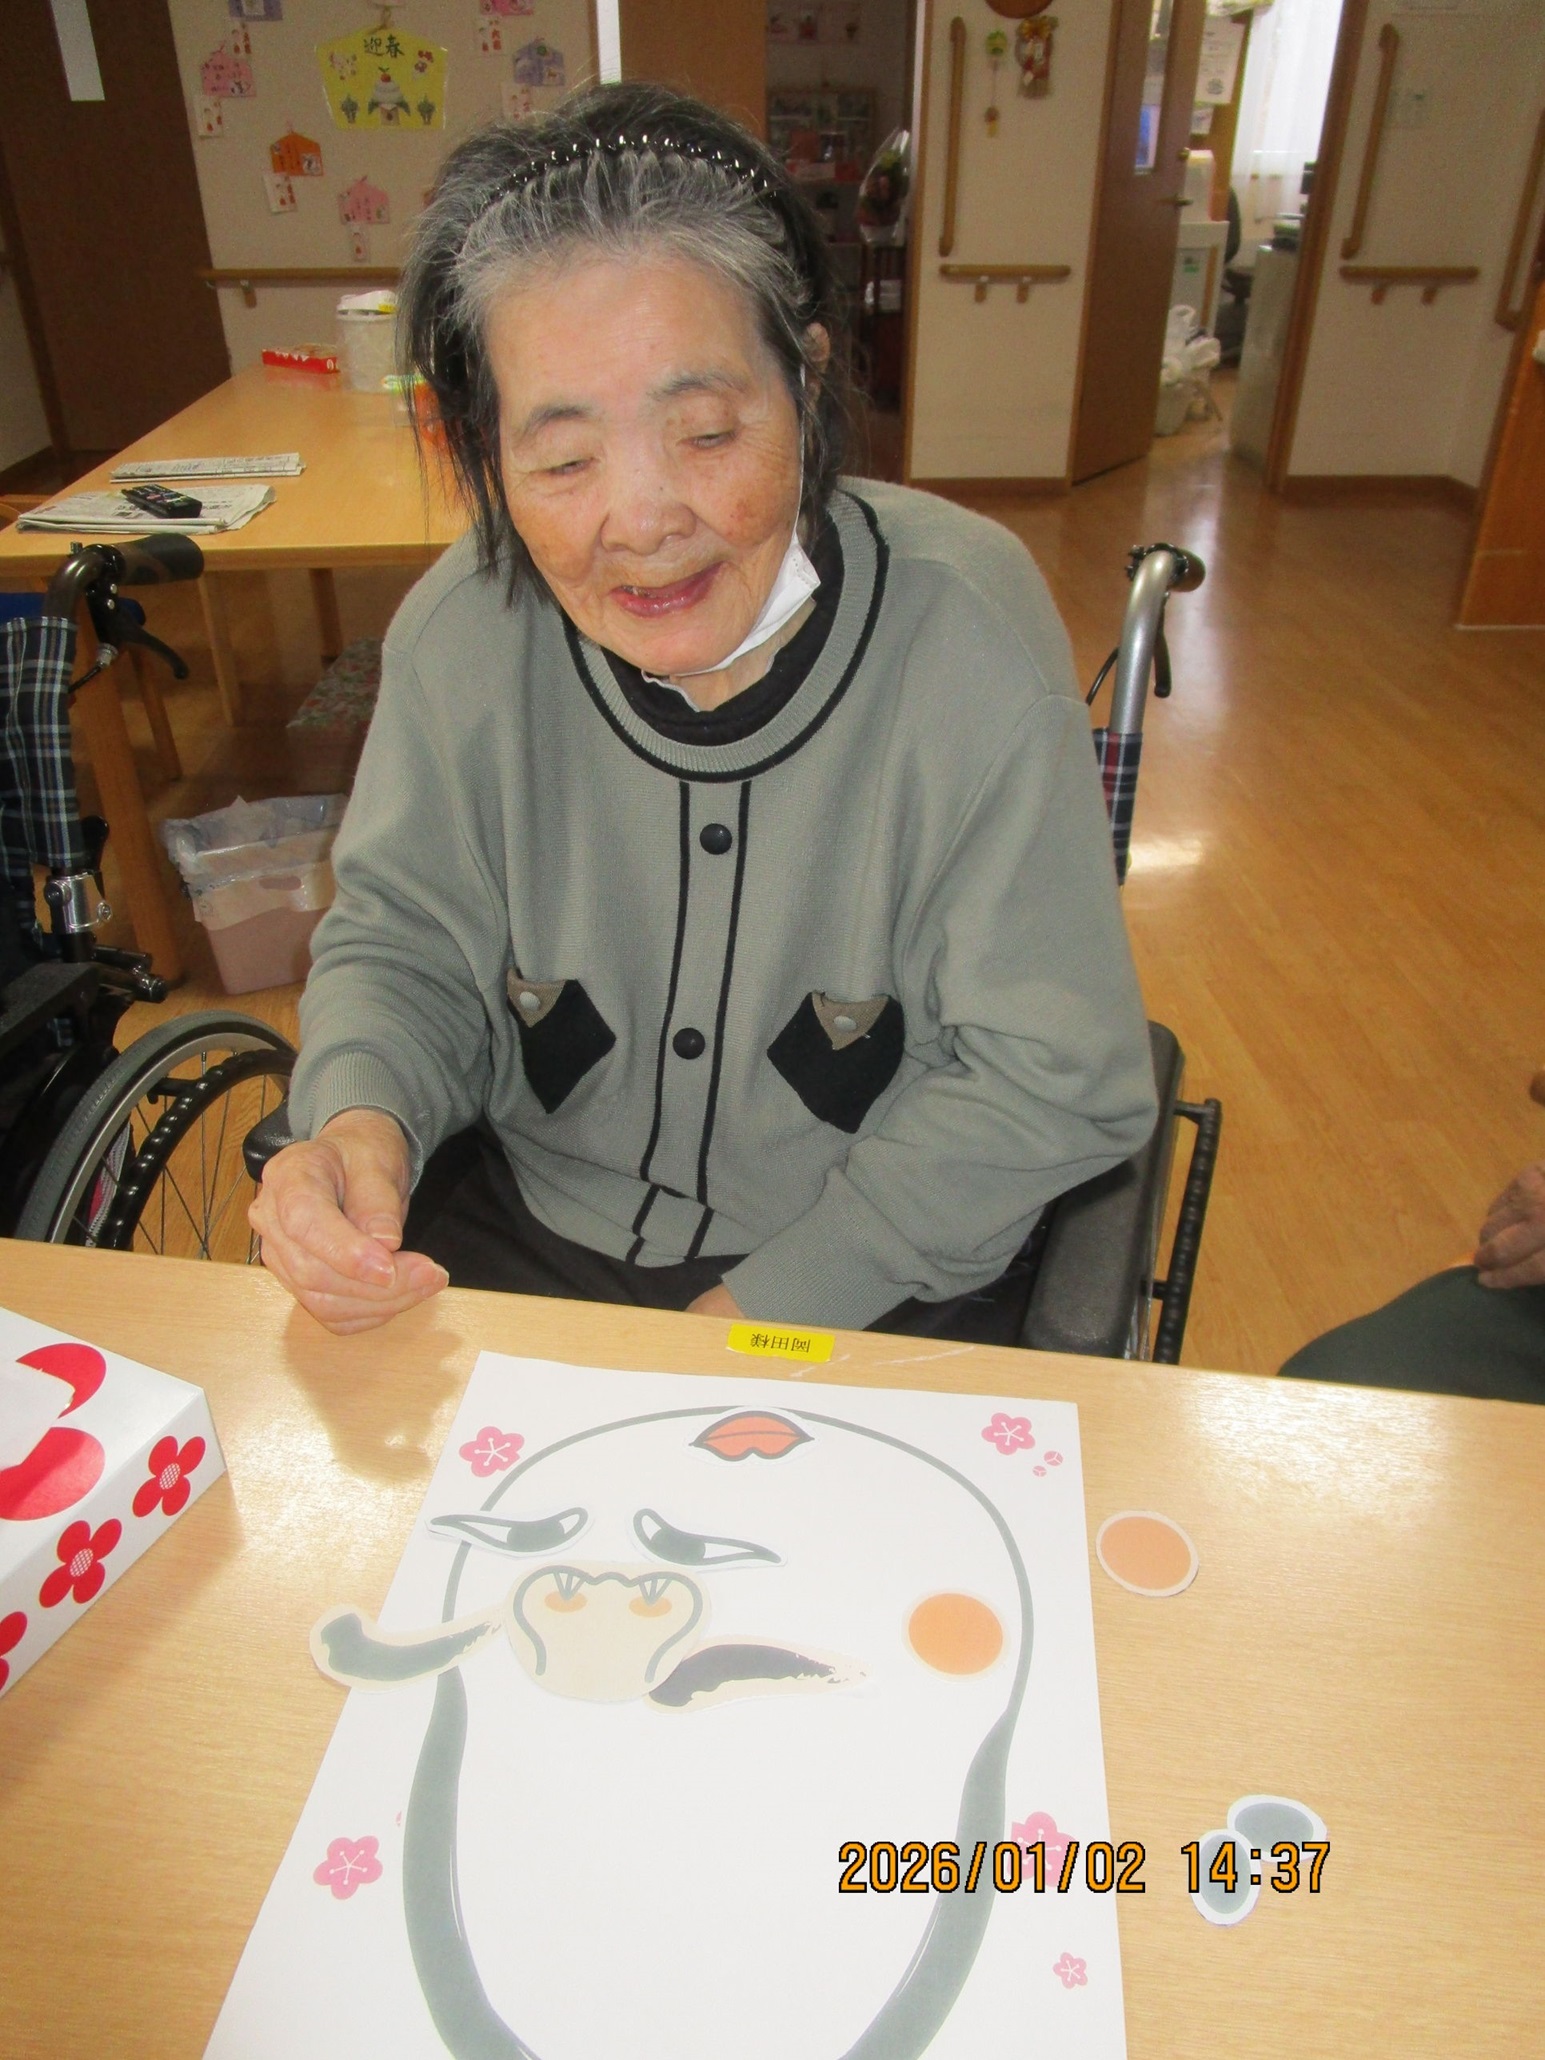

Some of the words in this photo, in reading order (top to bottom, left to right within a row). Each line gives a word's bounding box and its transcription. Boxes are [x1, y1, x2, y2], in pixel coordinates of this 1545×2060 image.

[363, 34, 405, 58] 迎春
[750, 1333, 811, 1354] 岡田様
